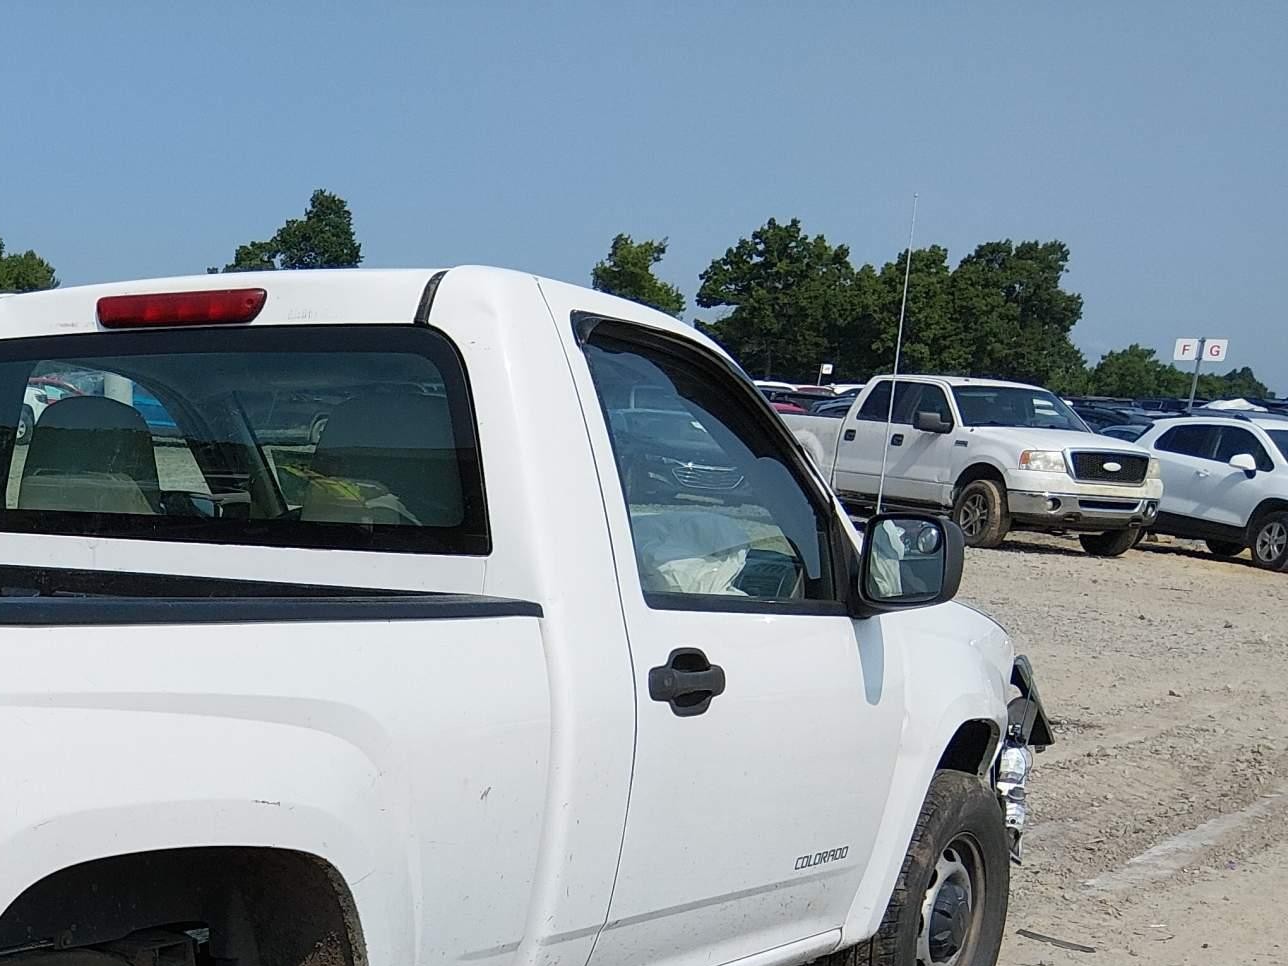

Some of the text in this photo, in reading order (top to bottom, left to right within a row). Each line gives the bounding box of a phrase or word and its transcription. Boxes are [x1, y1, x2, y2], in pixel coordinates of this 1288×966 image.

[1181, 344, 1192, 356] F
[1209, 344, 1221, 357] G
[794, 845, 849, 871] COLORADO
